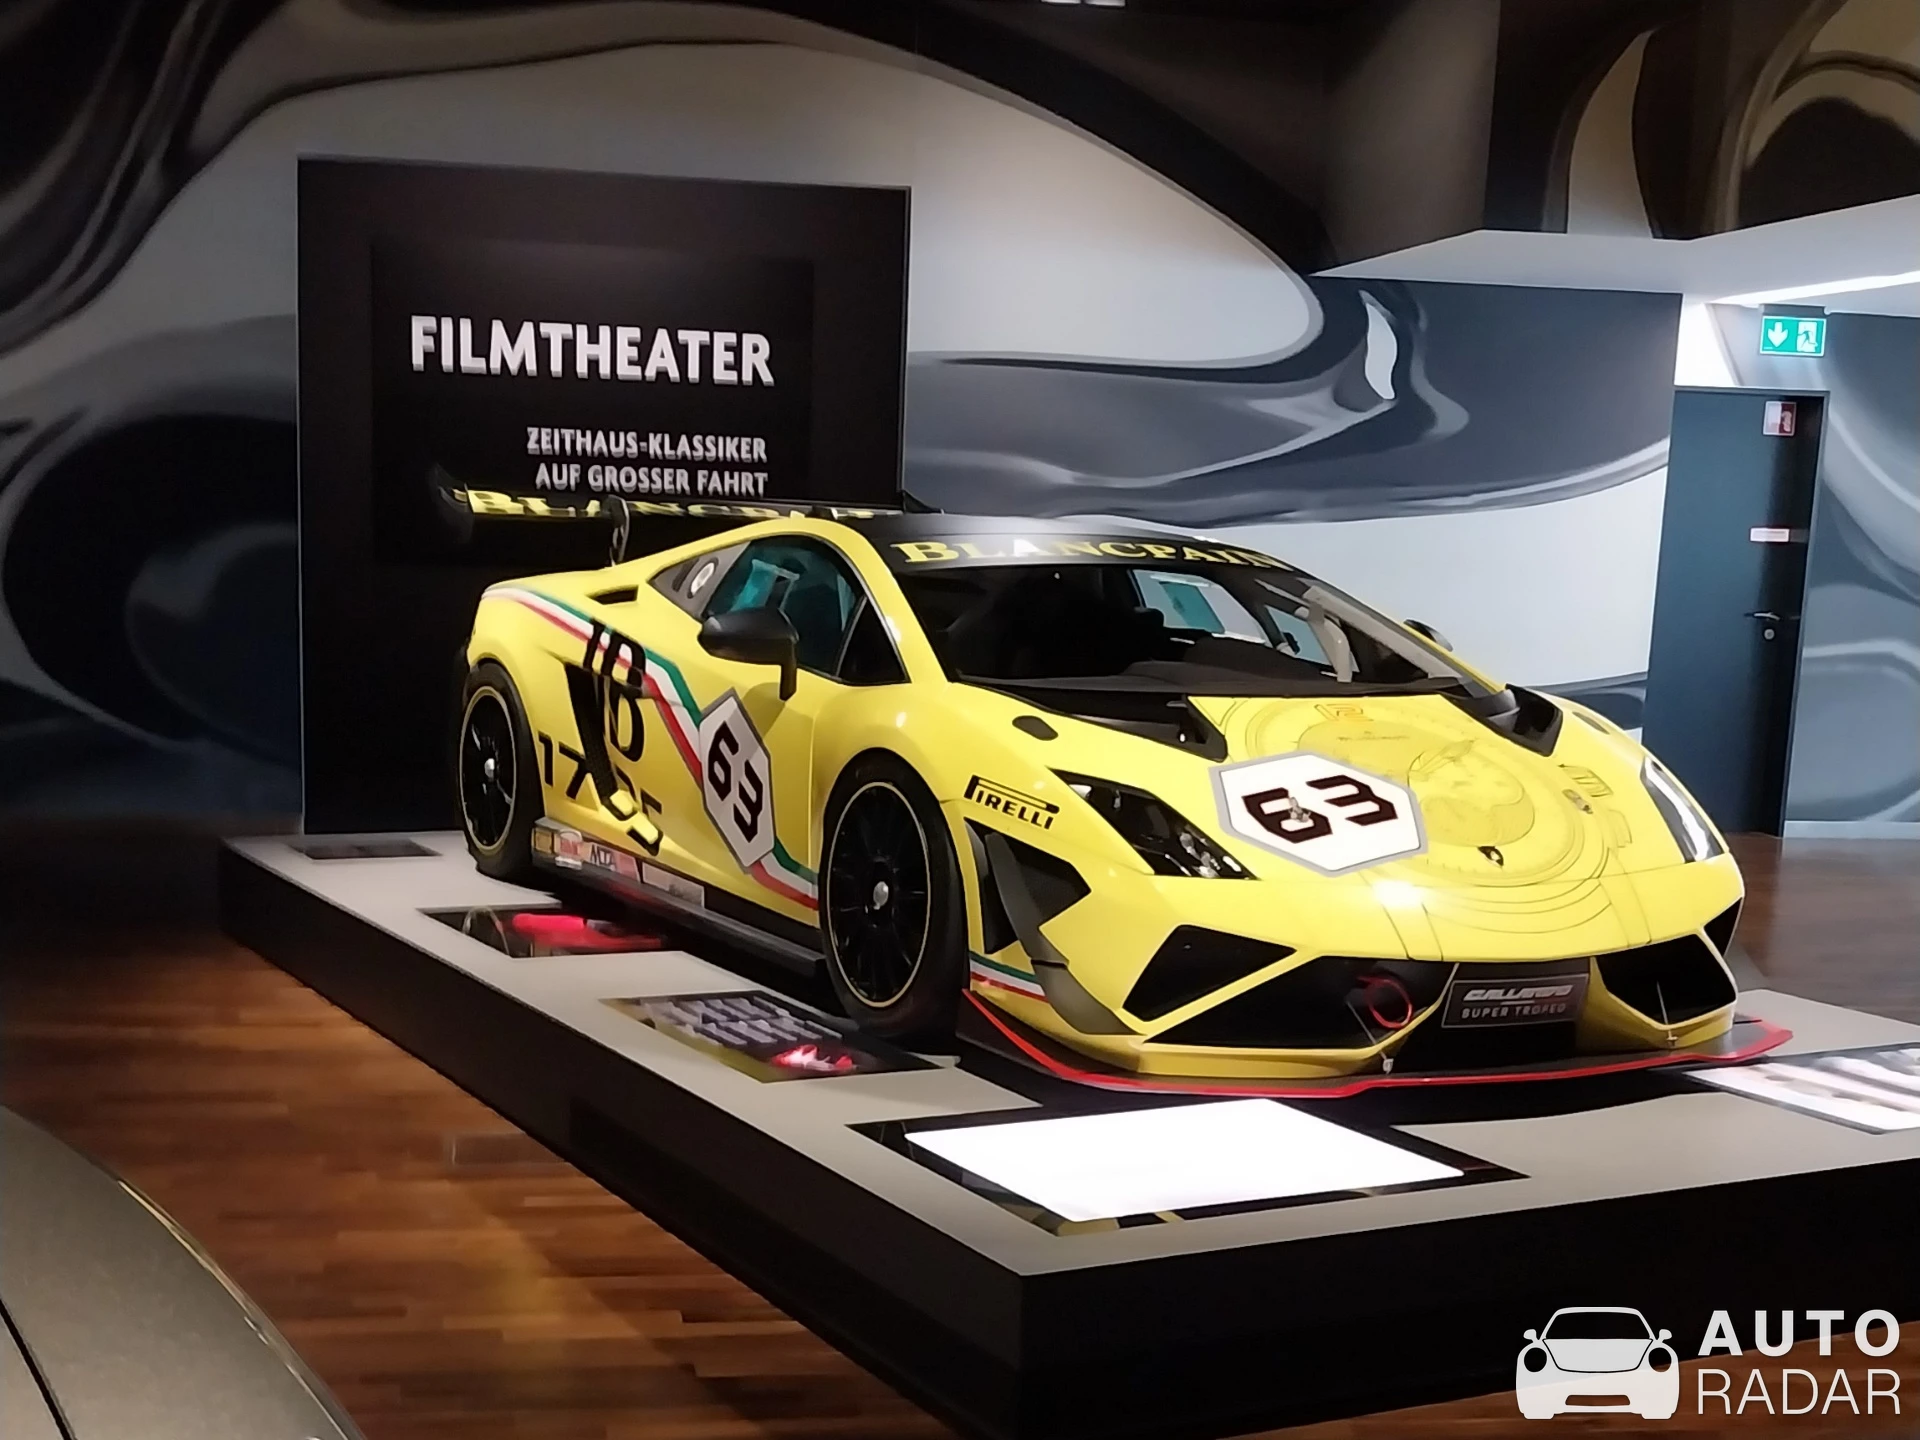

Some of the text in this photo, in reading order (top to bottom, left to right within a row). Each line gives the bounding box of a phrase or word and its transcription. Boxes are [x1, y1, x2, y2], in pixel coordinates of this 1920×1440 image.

[411, 315, 774, 386] FILMTHEATER
[527, 427, 767, 463] ZEITHAUS-KLASSIKER
[535, 463, 768, 497] AUF GROSSER FAHRT
[890, 539, 1294, 571] BLANCPAIN
[708, 721, 763, 843] 63
[963, 774, 1060, 830] PIRELLI
[1242, 775, 1398, 843] 63
[1461, 1003, 1567, 1019] SUPER TROFEO
